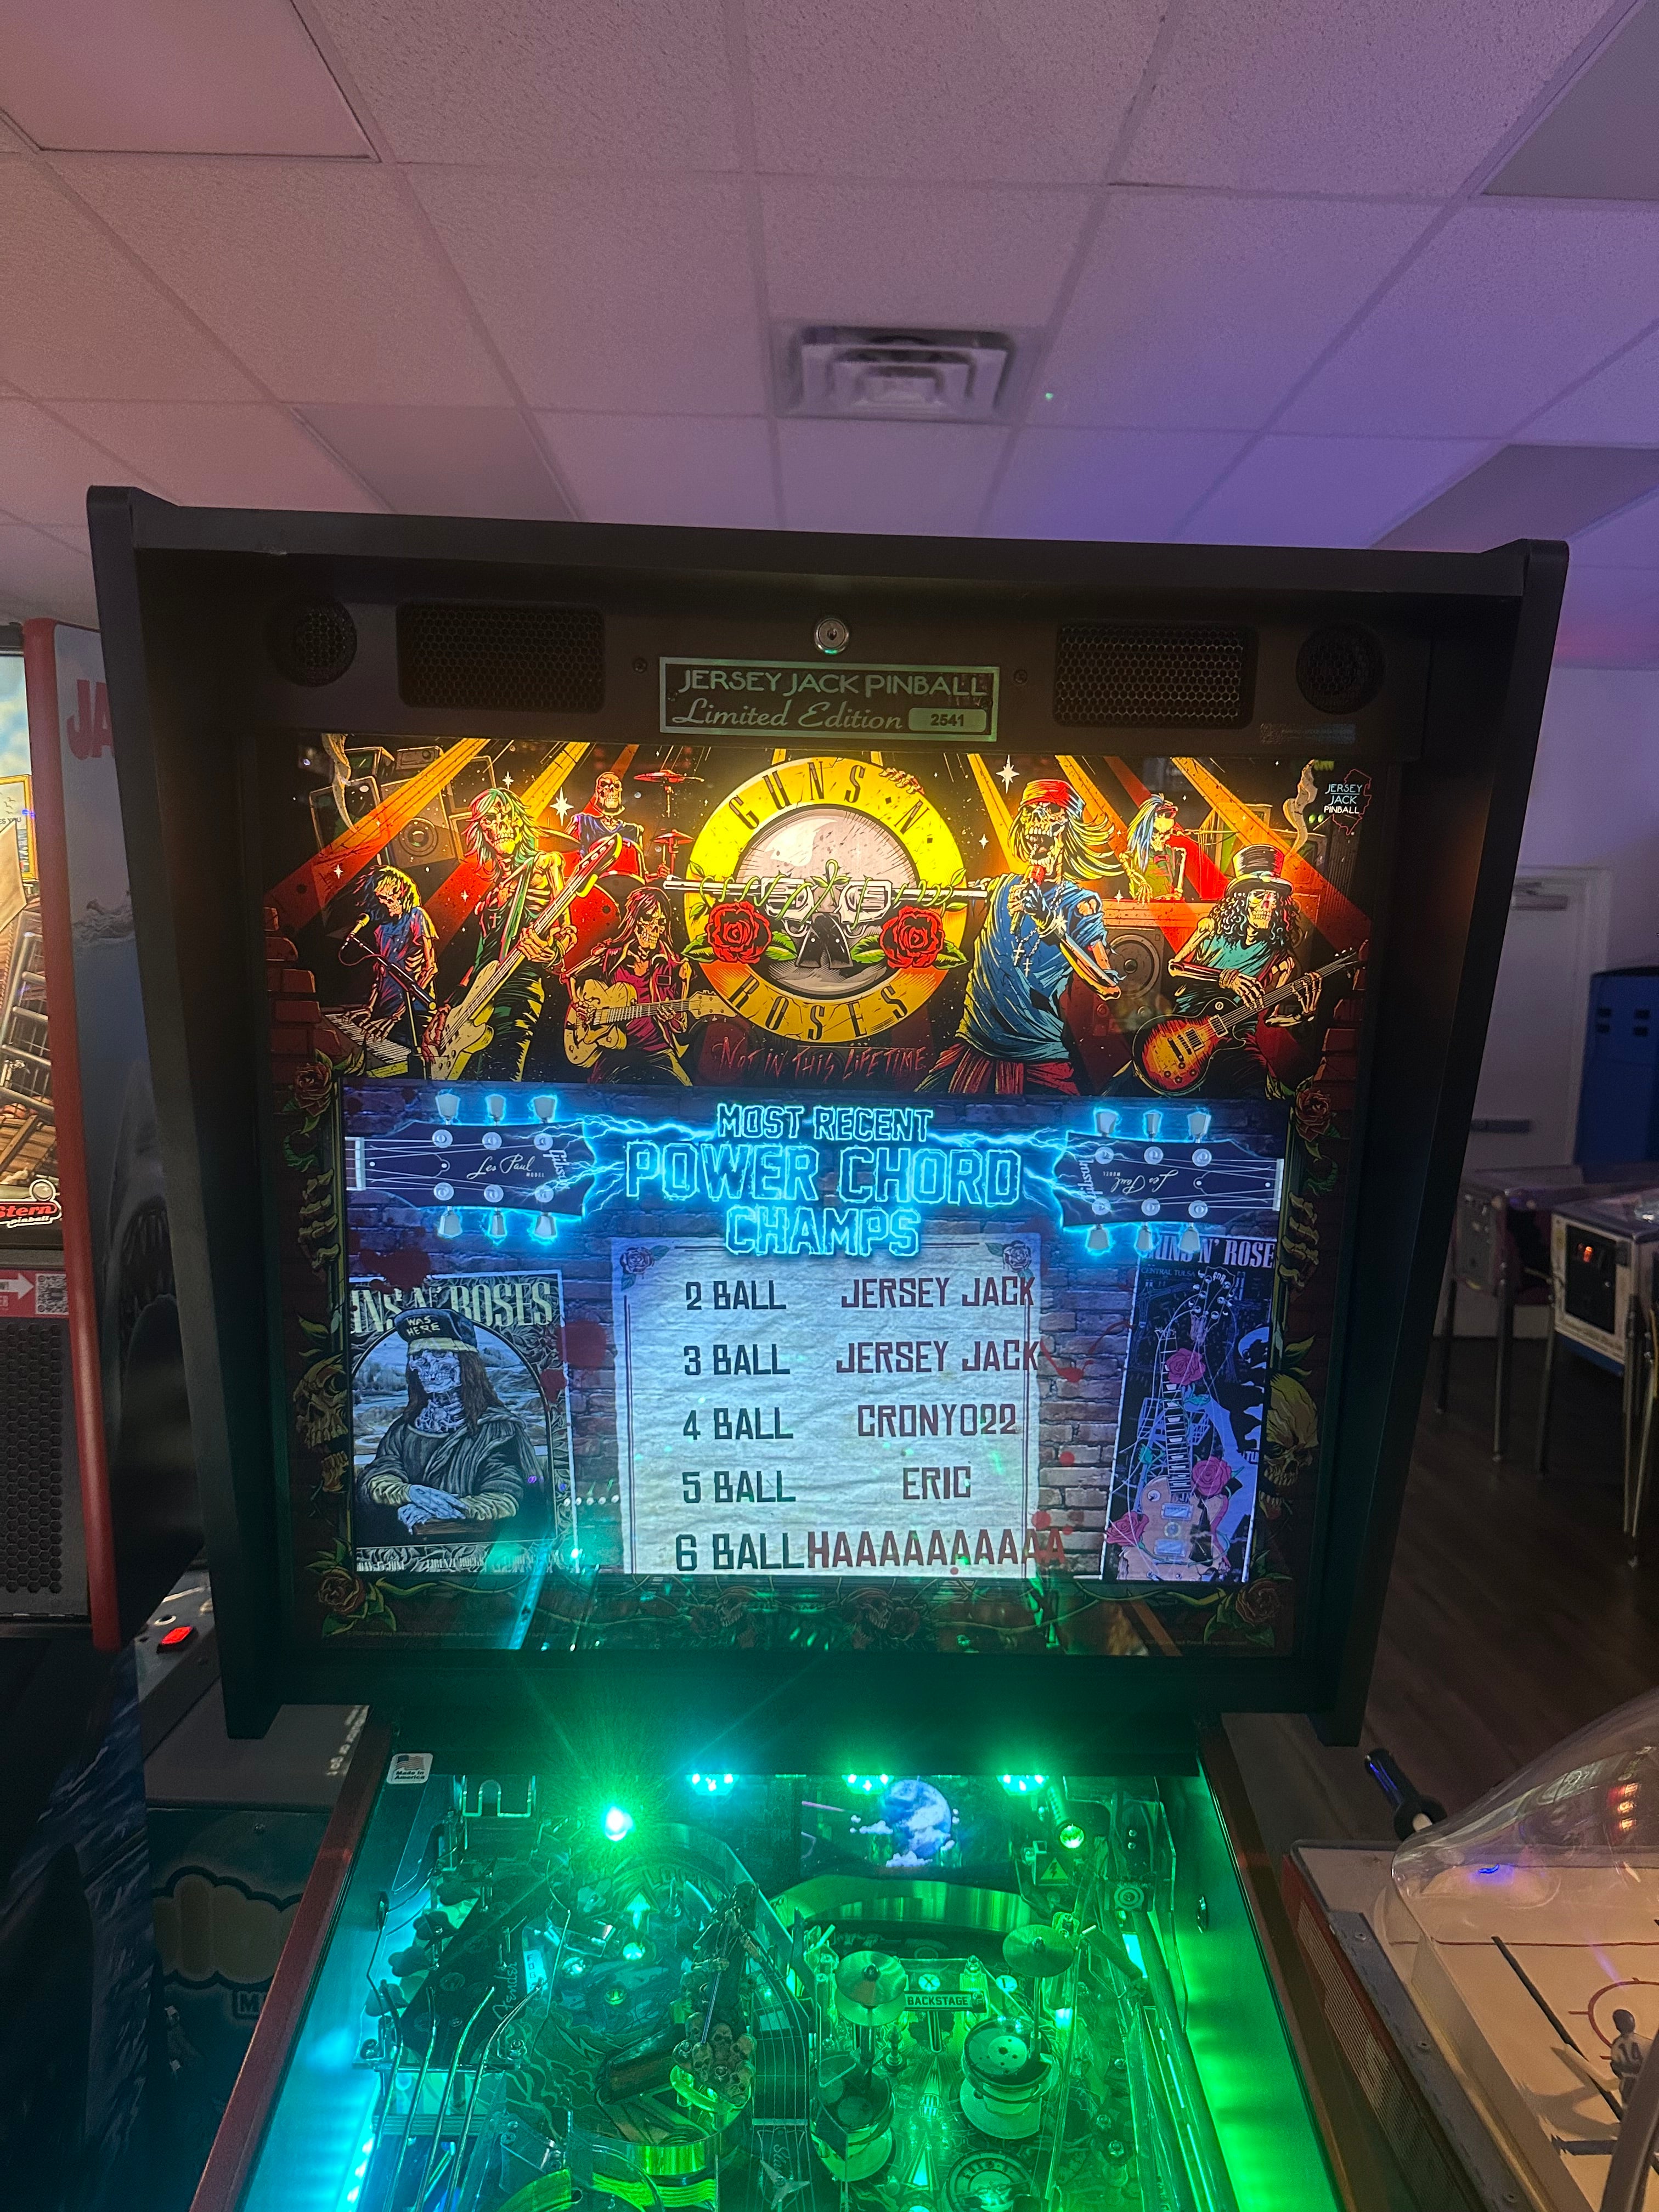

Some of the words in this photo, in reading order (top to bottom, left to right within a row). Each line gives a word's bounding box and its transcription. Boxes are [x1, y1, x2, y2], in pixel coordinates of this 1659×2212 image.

[679, 670, 781, 693] JERSEY
[782, 674, 860, 697] JACK
[865, 674, 988, 698] PINBALL
[672, 698, 792, 727] Limited
[798, 702, 903, 730] Edition
[930, 713, 964, 727] 2541
[729, 760, 866, 831] GUNS
[1324, 783, 1363, 794] JERSEY
[1328, 795, 1357, 805] JACK
[1323, 805, 1360, 815] PINBALL
[727, 975, 909, 1041] ROSES
[717, 1103, 804, 1139] MOST
[813, 1105, 934, 1142] RECENT
[466, 1156, 496, 1180] Les
[499, 1154, 536, 1174] Paul
[625, 1140, 820, 1203] POWER
[839, 1146, 1022, 1207] CHORD
[1148, 1169, 1179, 1193] Les
[1110, 1175, 1146, 1195] Paul
[725, 1205, 921, 1257] CHAMPS
[450, 1281, 552, 1327] ROSES
[686, 1281, 702, 1310] 2
[713, 1279, 787, 1310] BALL
[841, 1277, 950, 1308] JERSEY
[961, 1276, 1036, 1307] JACK
[407, 1315, 432, 1327] WAS
[407, 1323, 441, 1335] HERE
[684, 1345, 701, 1376] 3
[713, 1343, 791, 1375] BALL
[836, 1340, 949, 1373] JERSEY
[961, 1339, 1040, 1372] JACK
[683, 1409, 701, 1441] 4
[714, 1407, 794, 1440] BALL
[682, 1471, 701, 1504] 5
[714, 1470, 797, 1504] BALL
[902, 1466, 972, 1500] ERIC
[675, 1534, 697, 1571] 6
[713, 1532, 805, 1570] BALL
[492, 1961, 518, 2021] Fender
[907, 1995, 969, 2006] BACKSTAGE
